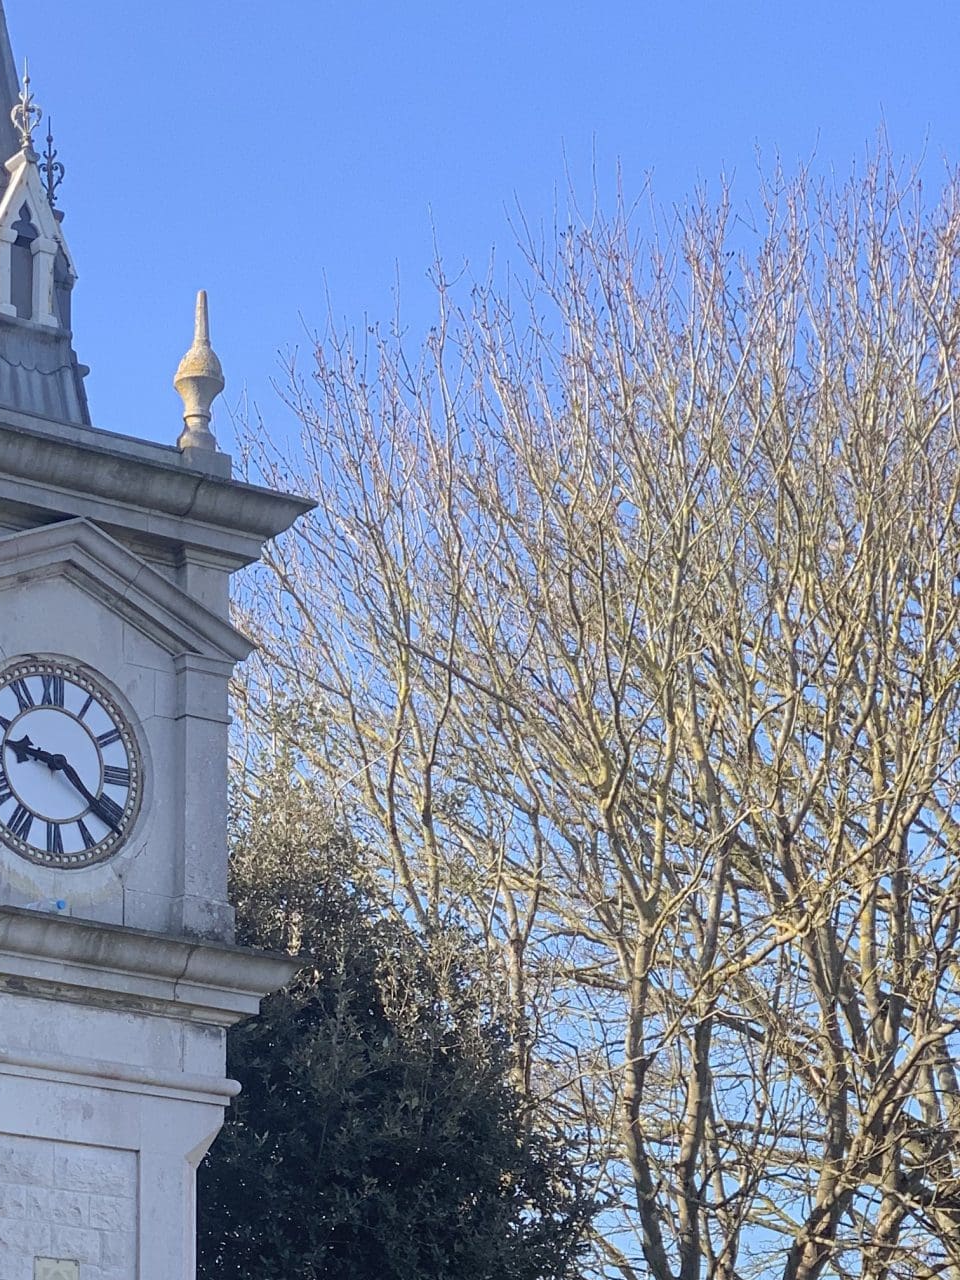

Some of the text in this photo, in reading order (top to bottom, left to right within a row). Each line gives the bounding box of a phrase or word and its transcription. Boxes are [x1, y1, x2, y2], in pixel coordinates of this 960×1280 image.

[8, 679, 36, 713] XI
[41, 675, 65, 709] XII
[77, 694, 95, 720] I
[96, 728, 122, 749] II
[103, 765, 130, 787] III
[6, 803, 34, 843] VII
[46, 820, 65, 855] VI
[76, 820, 97, 850] V
